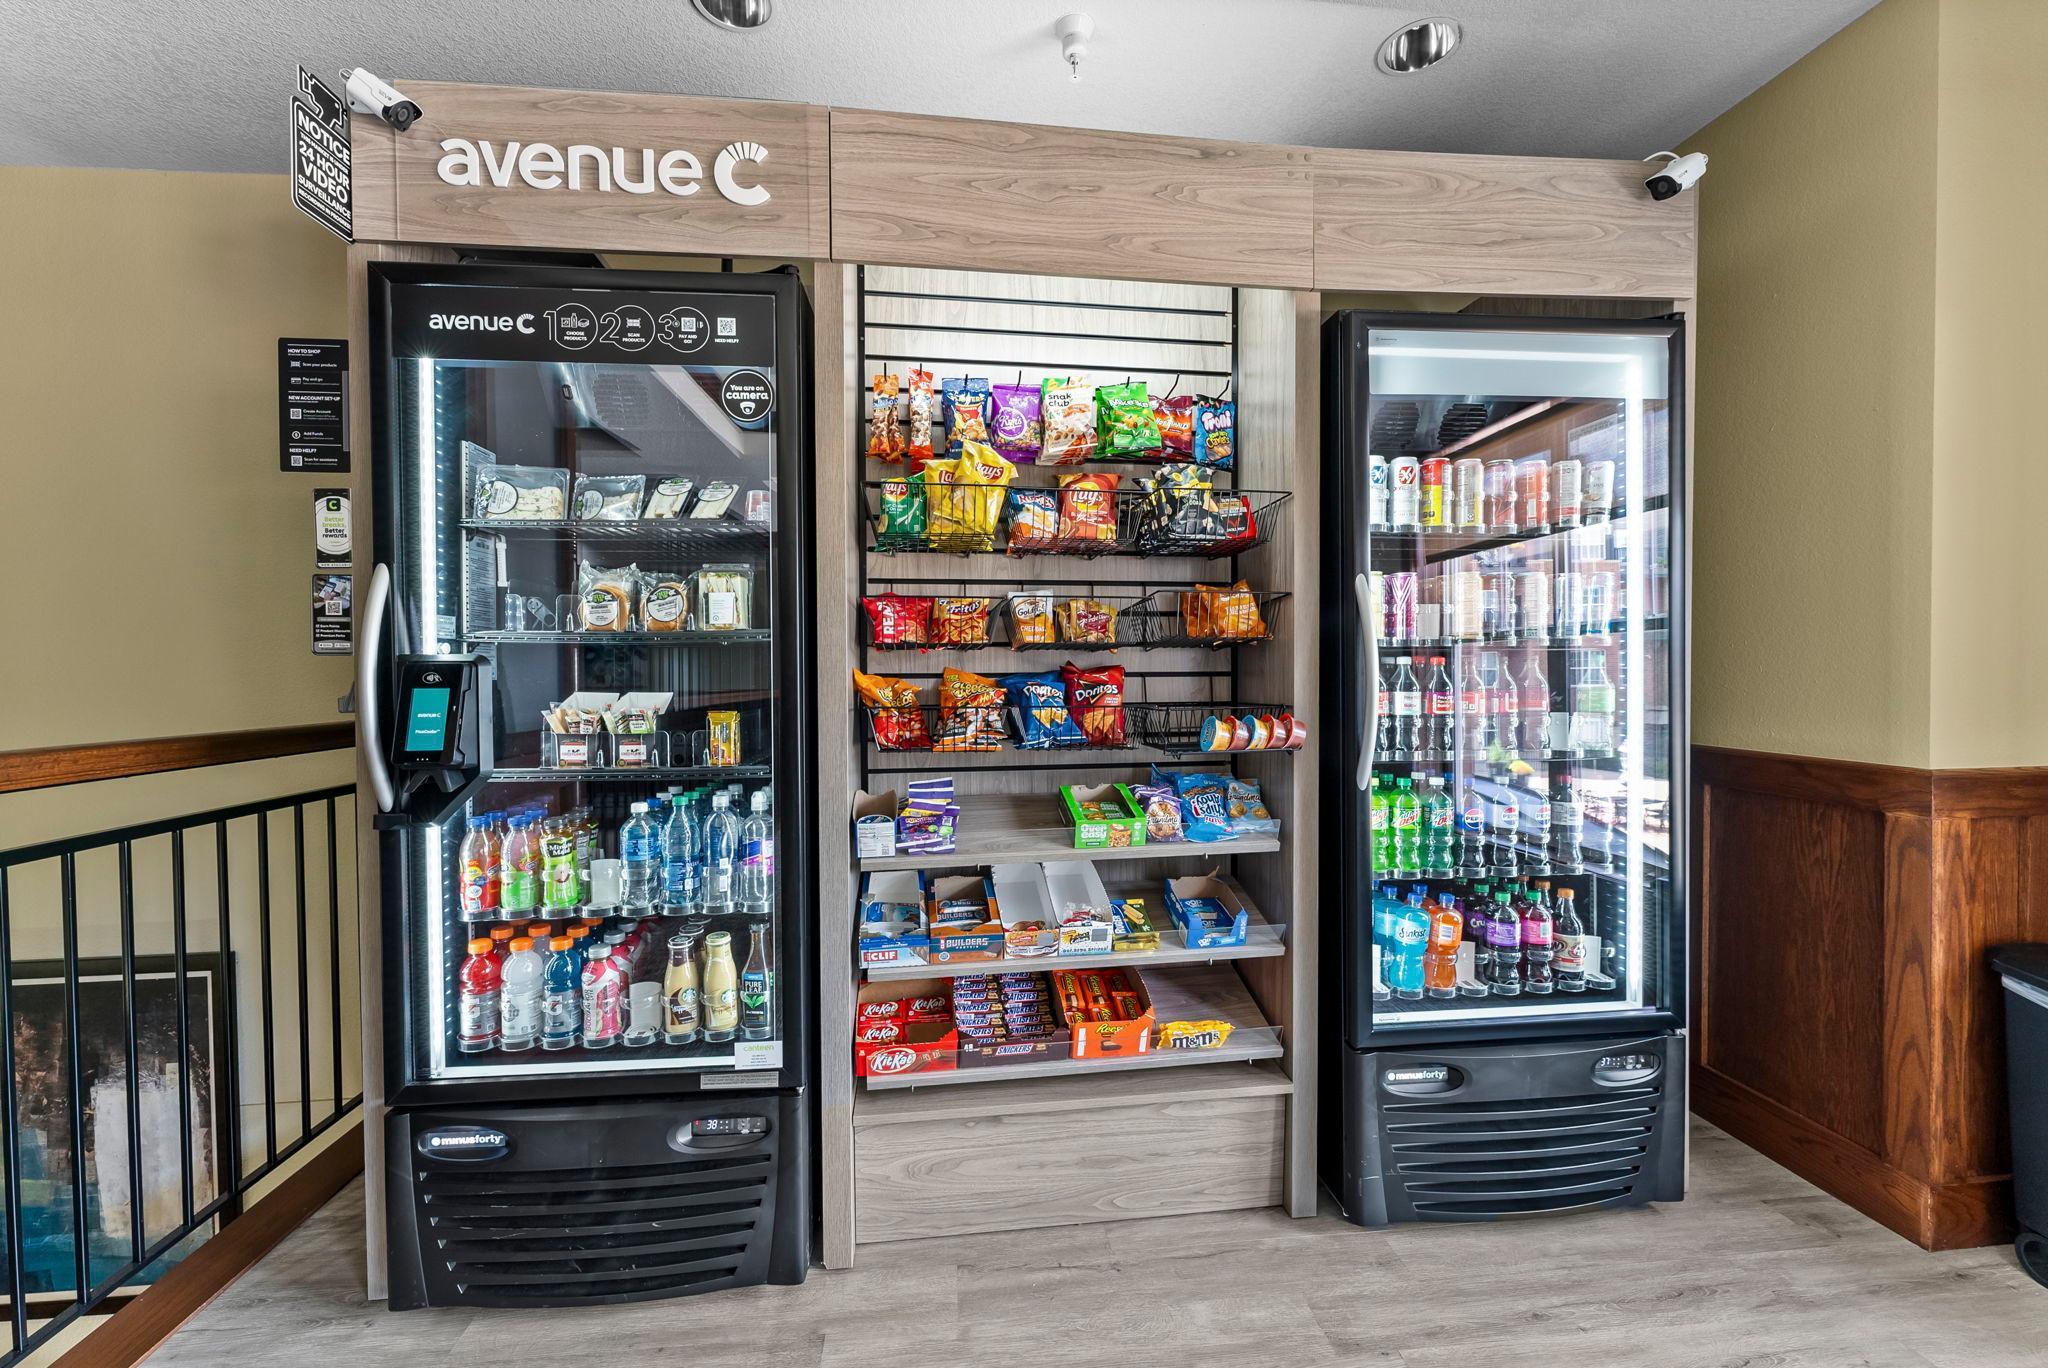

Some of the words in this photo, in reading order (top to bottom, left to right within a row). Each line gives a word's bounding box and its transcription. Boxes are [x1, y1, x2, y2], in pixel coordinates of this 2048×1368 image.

[298, 109, 351, 166] NOTICE
[299, 140, 315, 162] 24
[316, 153, 350, 190] HOUR
[436, 138, 703, 197] avenue
[713, 141, 771, 206] C
[301, 156, 348, 204] VIDEO
[298, 174, 351, 220] SURVEILLANCE
[429, 313, 514, 332] avenue
[516, 313, 536, 335] C
[600, 312, 621, 343] 2
[657, 313, 677, 345] 3
[726, 391, 769, 400] camera
[1048, 400, 1070, 408] club
[1201, 410, 1231, 431] Trolli
[1075, 683, 1118, 702] Doritos
[945, 938, 989, 948] BUILDERS
[870, 952, 897, 961] CLIF
[864, 1004, 898, 1016] KitKat
[959, 1003, 989, 1012] SNICKERS
[864, 1028, 899, 1040] KitKat
[997, 1044, 1033, 1055] SNICKERS
[872, 1052, 916, 1071] KitKat
[1600, 1057, 1611, 1067] 37
[1395, 1070, 1446, 1081] minusforty
[706, 1119, 718, 1130] 38
[441, 1133, 503, 1148] minusforty
